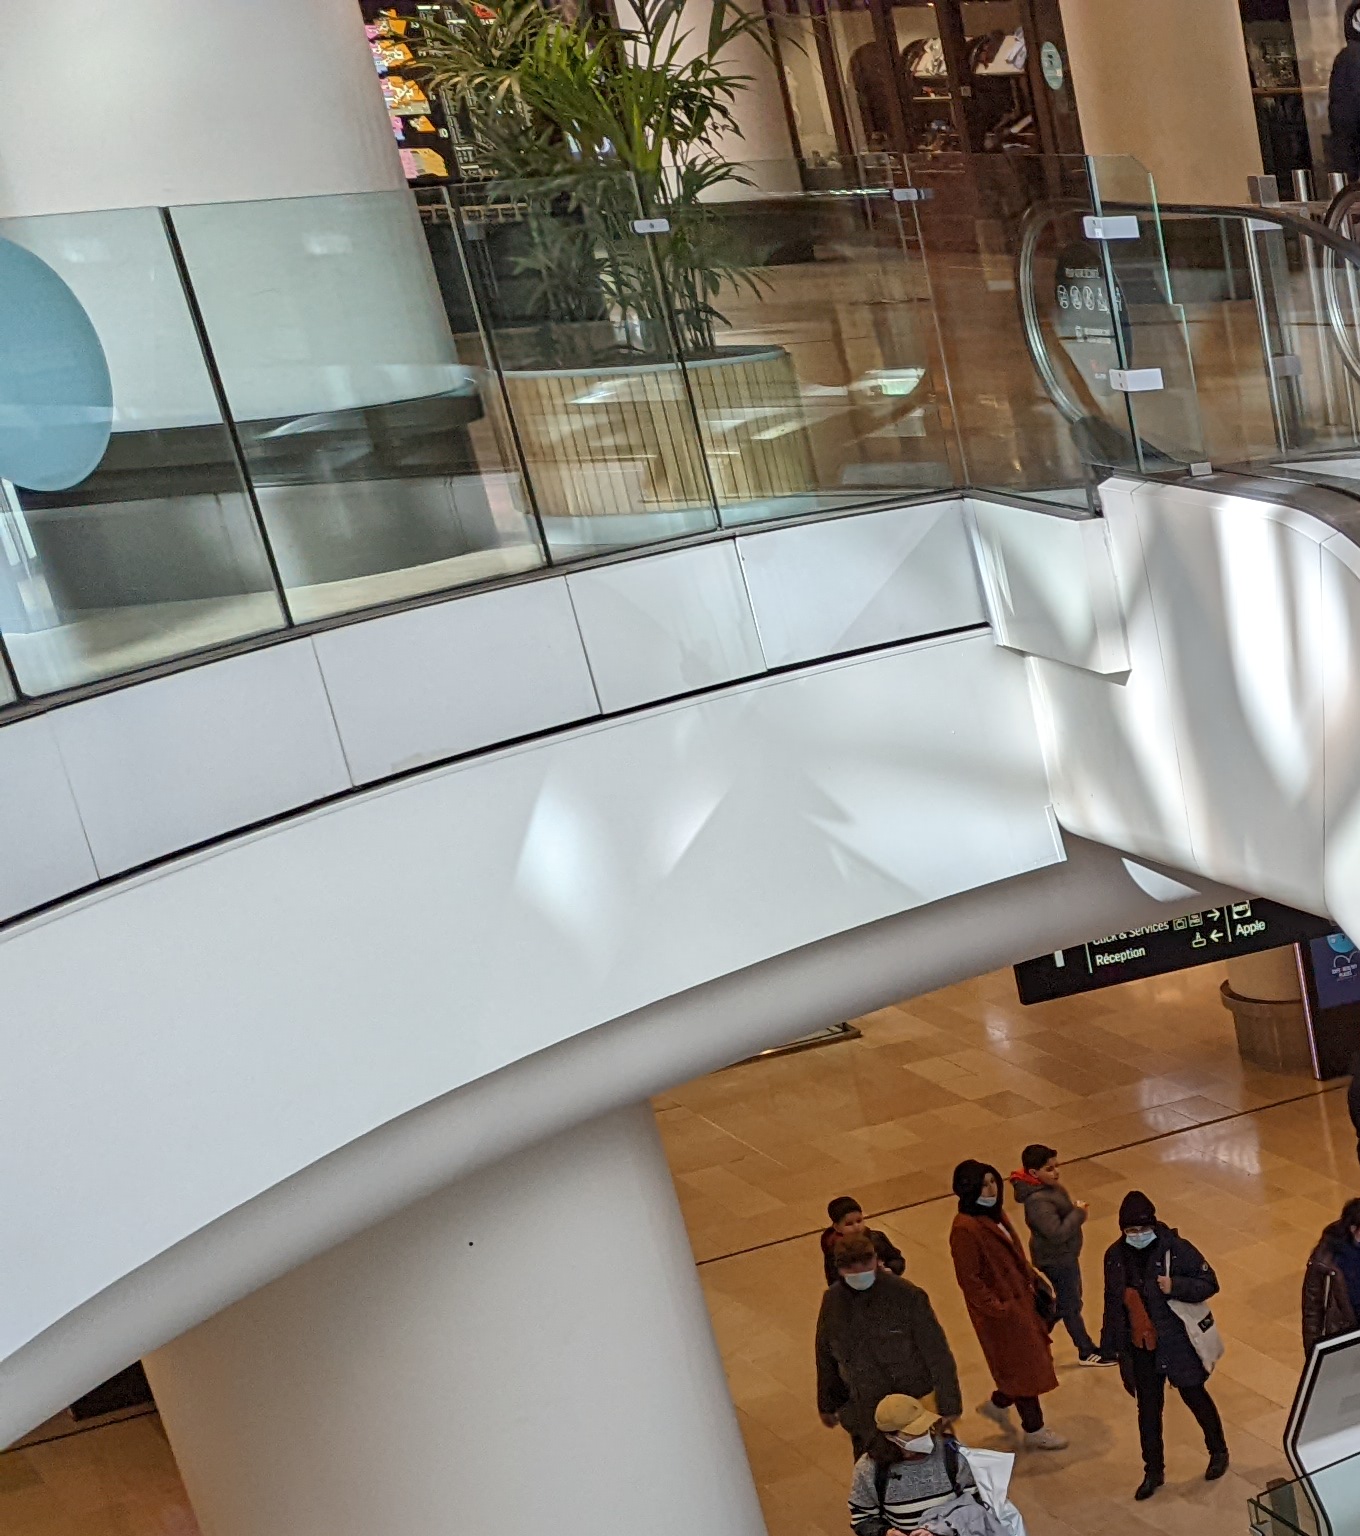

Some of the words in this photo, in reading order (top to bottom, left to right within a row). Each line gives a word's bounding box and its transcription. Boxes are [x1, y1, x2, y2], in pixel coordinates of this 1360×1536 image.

[1129, 920, 1170, 938] Services
[1235, 919, 1266, 937] Apple
[1095, 947, 1146, 966] Réception
